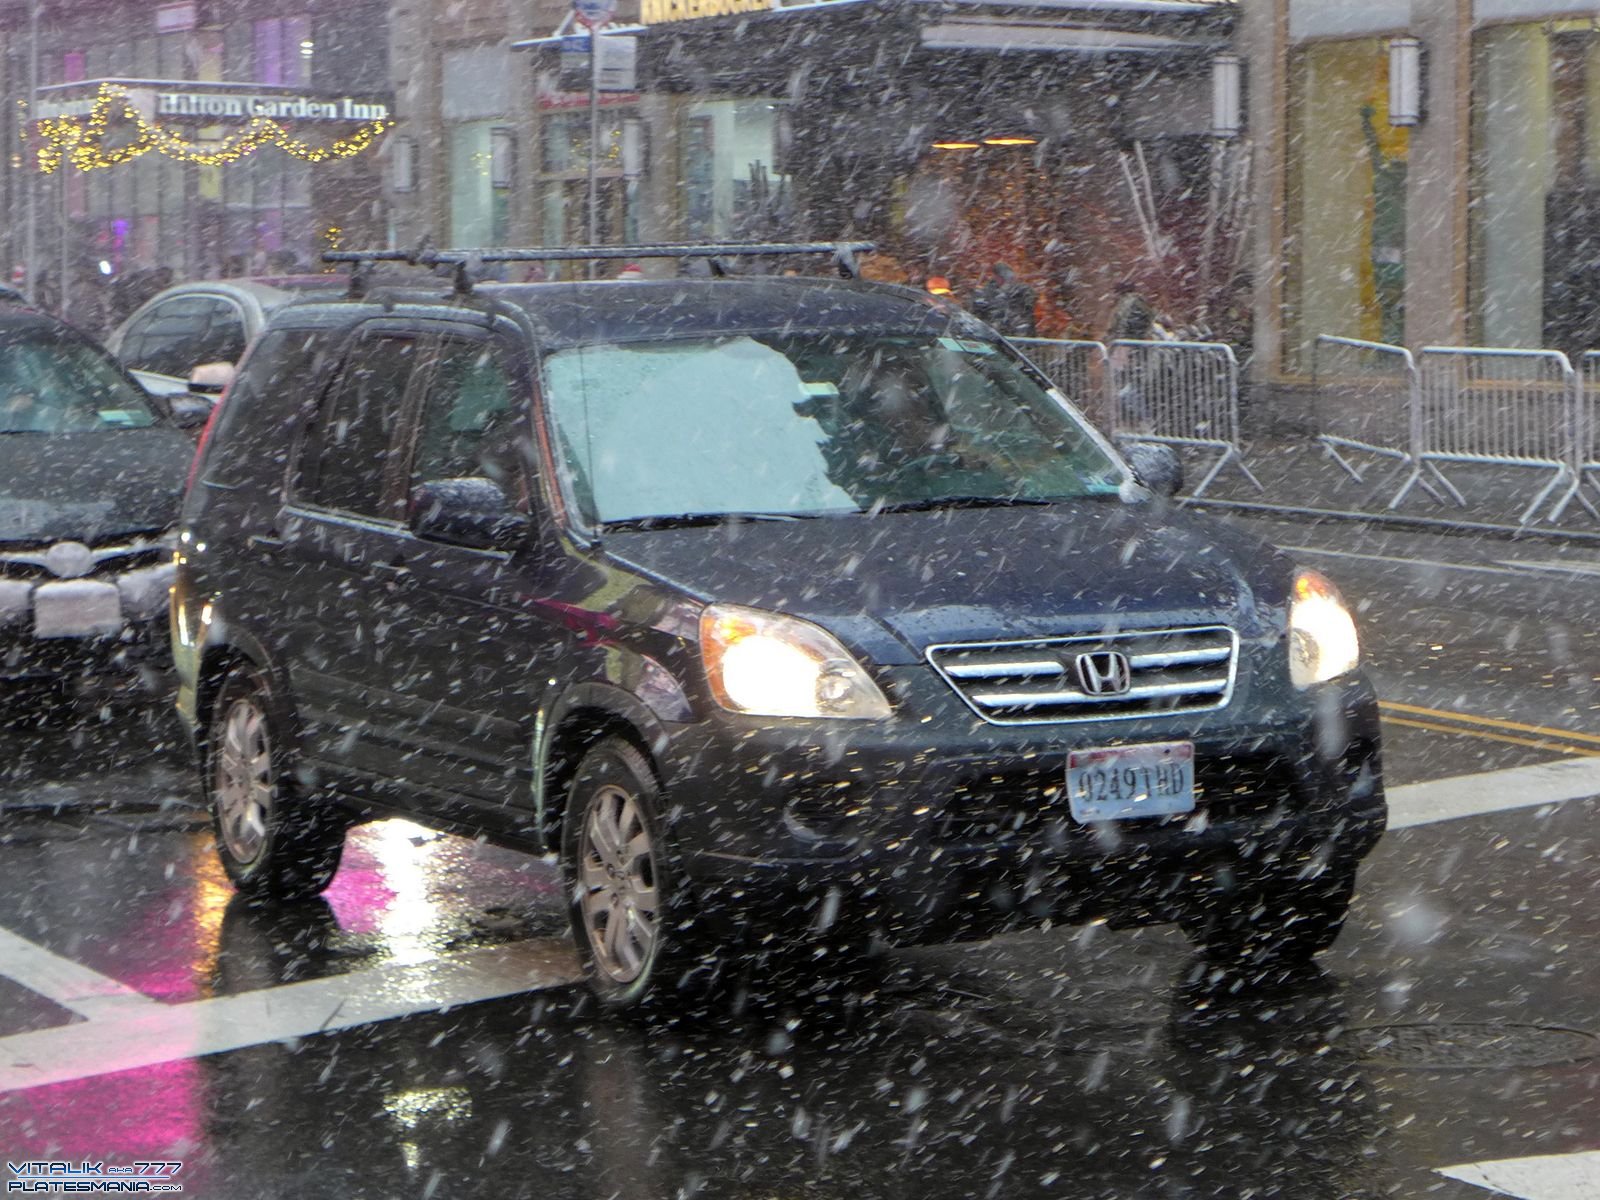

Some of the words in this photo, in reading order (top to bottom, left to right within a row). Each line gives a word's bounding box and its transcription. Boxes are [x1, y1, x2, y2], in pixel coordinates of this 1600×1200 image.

[158, 92, 241, 115] Hilton
[247, 95, 337, 119] Garden
[343, 98, 387, 120] Inn
